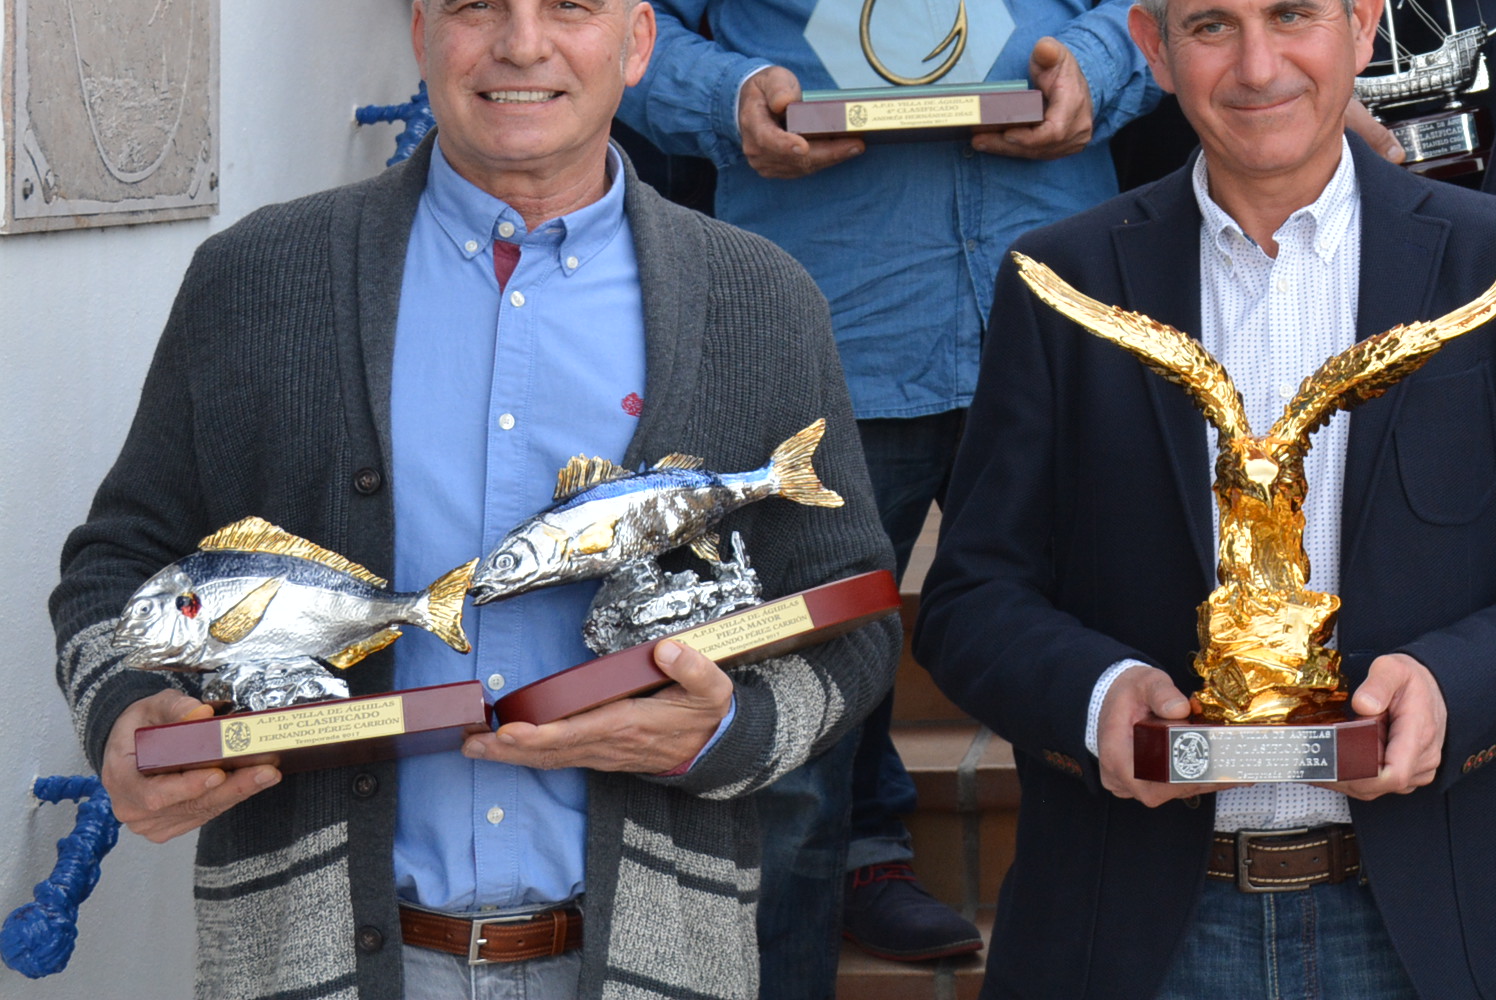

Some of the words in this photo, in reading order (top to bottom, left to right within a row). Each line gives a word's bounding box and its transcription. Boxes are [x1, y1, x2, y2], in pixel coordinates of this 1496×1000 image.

[897, 105, 960, 114] CLASIFICADO
[716, 626, 745, 641] PIEZA
[747, 615, 781, 629] MAYOR
[720, 618, 747, 631] VILLA
[292, 711, 324, 721] VILLA
[325, 708, 343, 717] DE
[296, 711, 380, 729] CLASIFICADO
[259, 730, 316, 743] FERNANDO
[318, 724, 352, 735] PÉREZ
[353, 717, 400, 730] CARRIÓN
[296, 735, 341, 745] Temporada
[342, 731, 360, 740] 2017
[1236, 743, 1321, 755] CLASIFICADO
